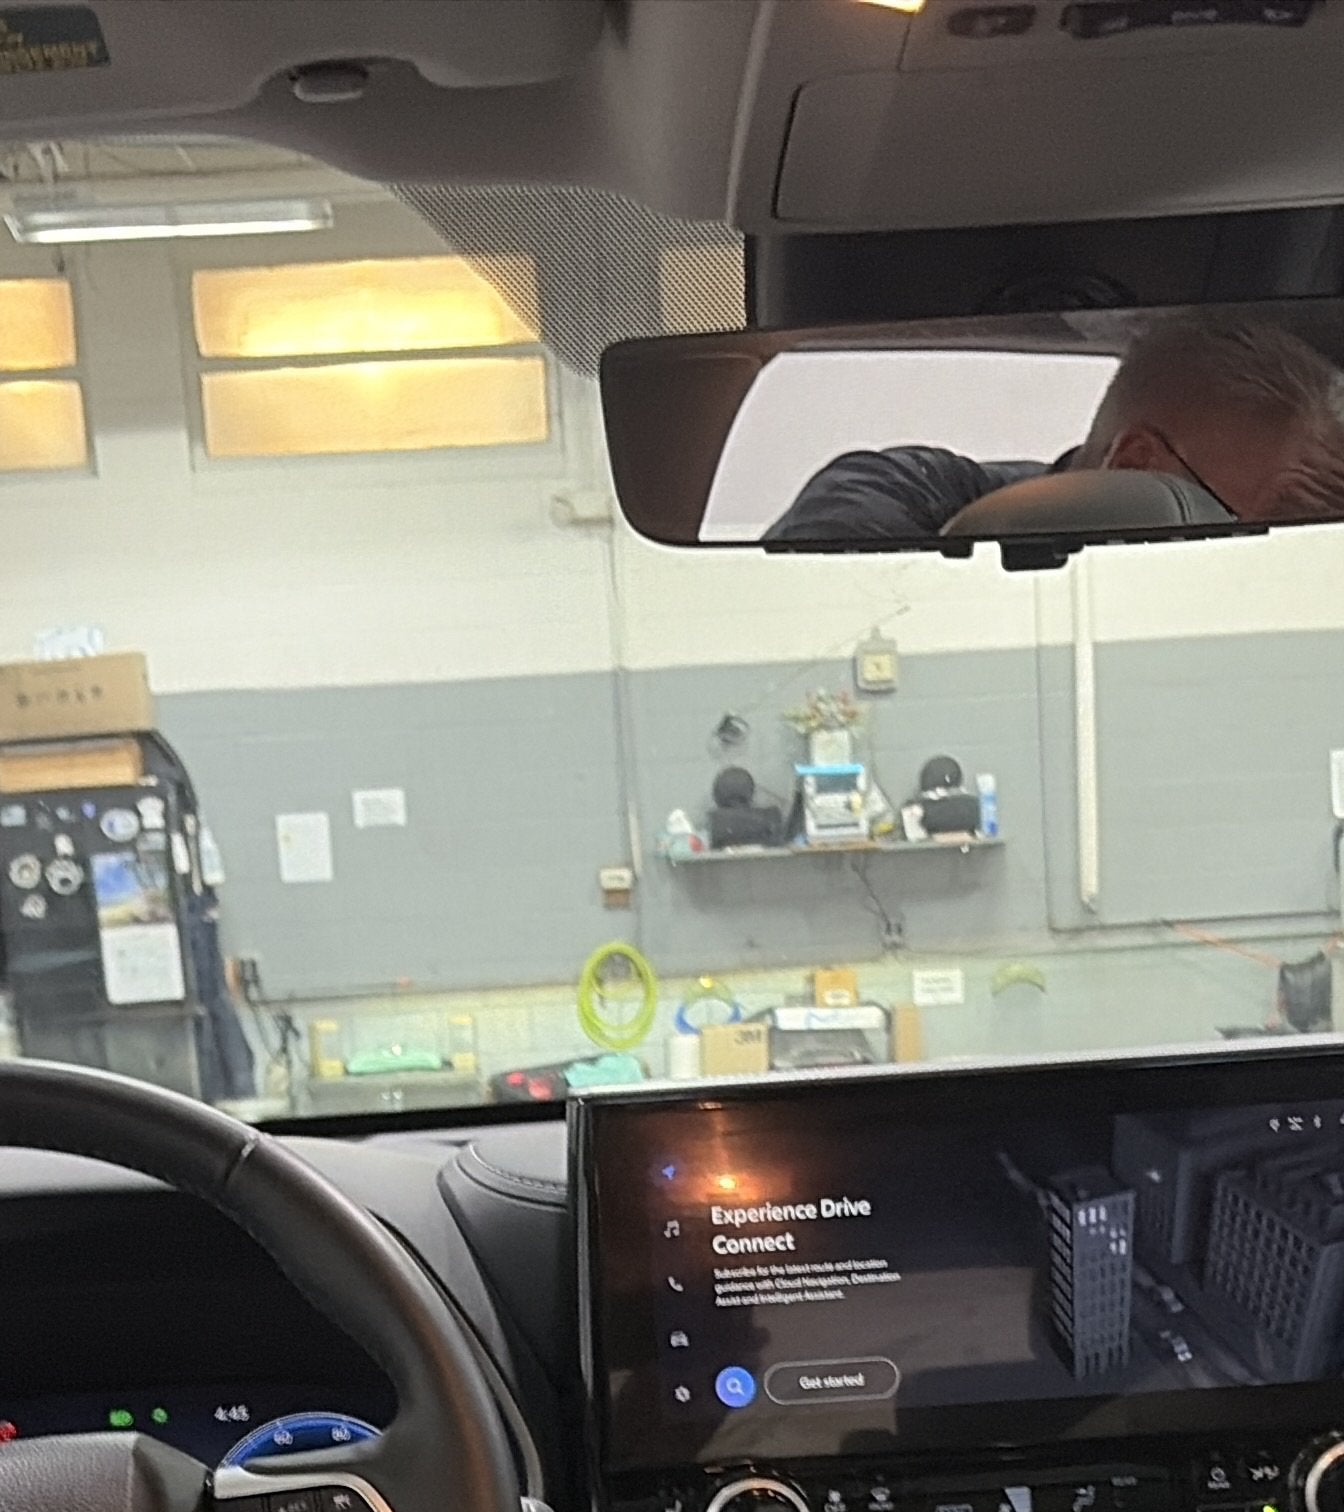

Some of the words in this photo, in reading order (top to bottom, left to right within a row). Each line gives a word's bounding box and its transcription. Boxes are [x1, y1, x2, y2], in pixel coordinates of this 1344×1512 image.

[711, 1201, 817, 1228] Experience
[820, 1196, 872, 1219] Drive
[712, 1232, 796, 1255] Connect
[799, 1375, 823, 1390] Get
[823, 1371, 865, 1388] started
